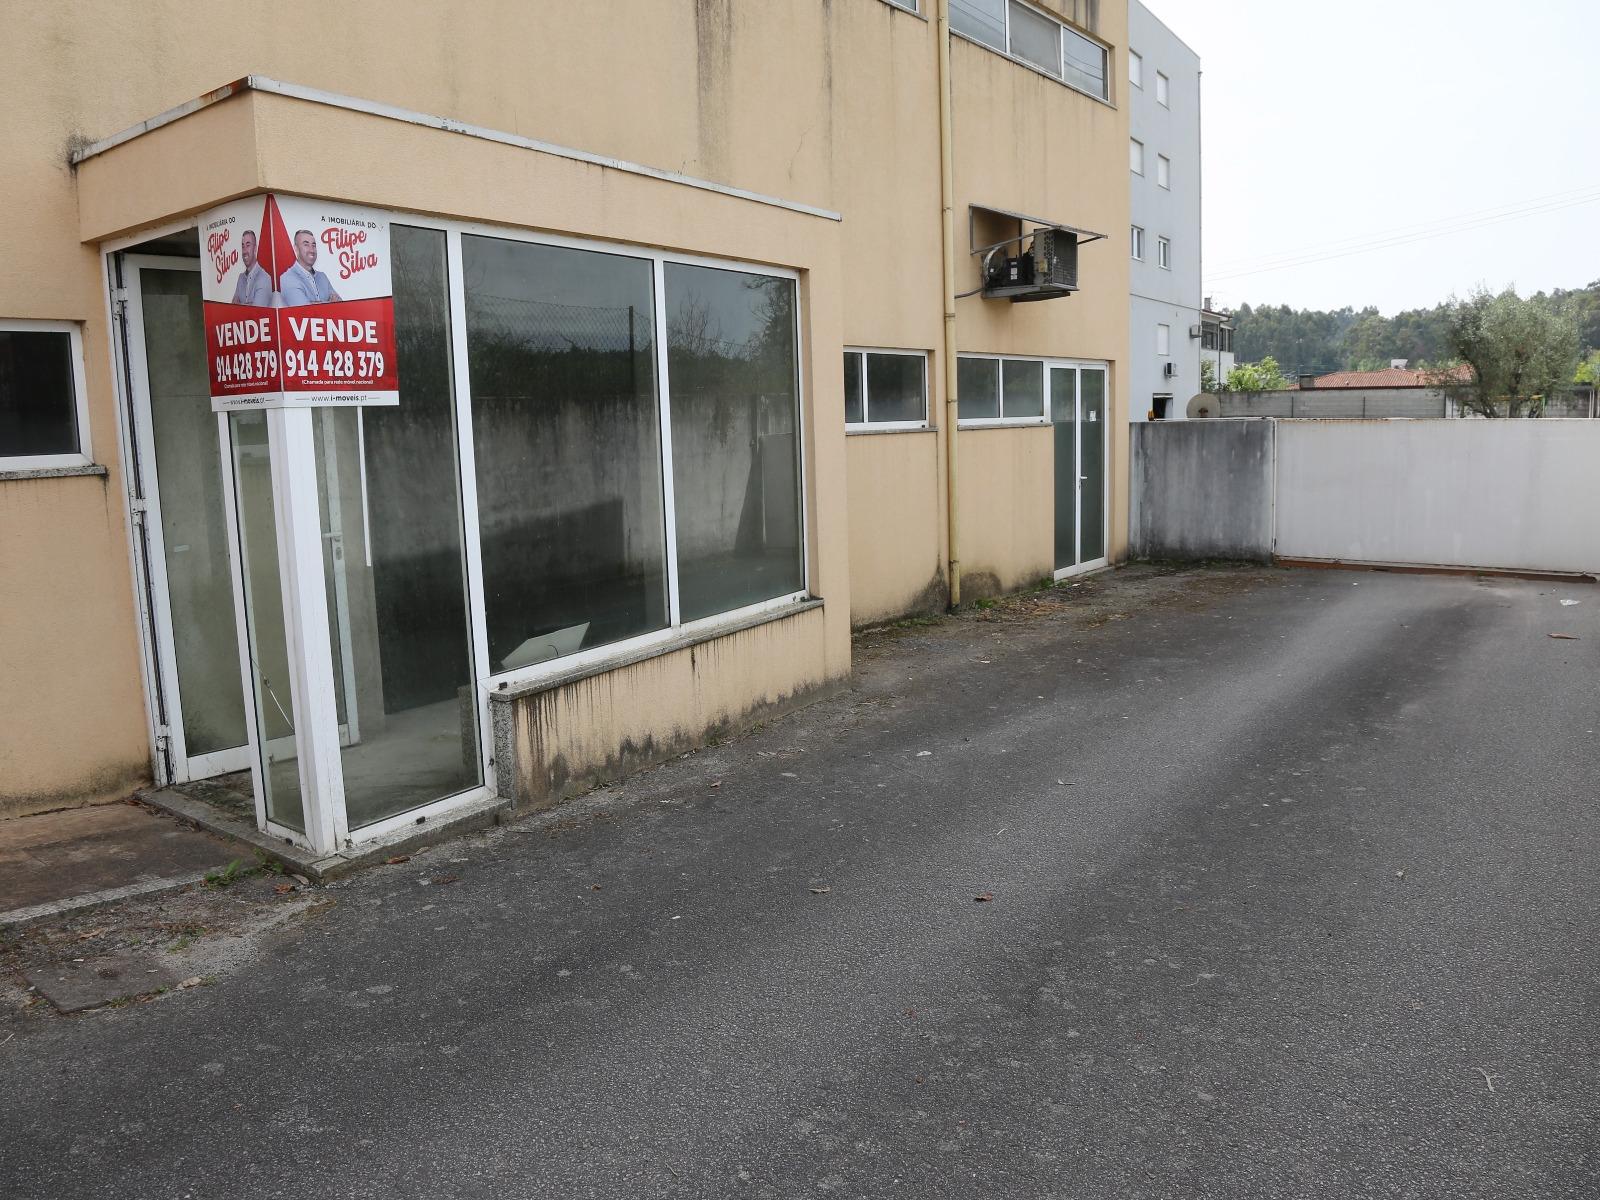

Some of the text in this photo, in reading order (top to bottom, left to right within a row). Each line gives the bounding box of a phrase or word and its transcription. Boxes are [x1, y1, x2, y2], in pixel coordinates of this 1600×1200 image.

[207, 228, 230, 262] Filipe
[320, 227, 367, 255] Filipe
[215, 248, 239, 284] Silva
[338, 250, 378, 280] Silva
[215, 318, 272, 348] VENDE
[288, 317, 378, 344] VENDE
[216, 350, 278, 383] 914 428 379
[285, 349, 385, 378] 914 428 379
[311, 393, 367, 402] www.i-moveis.pt
